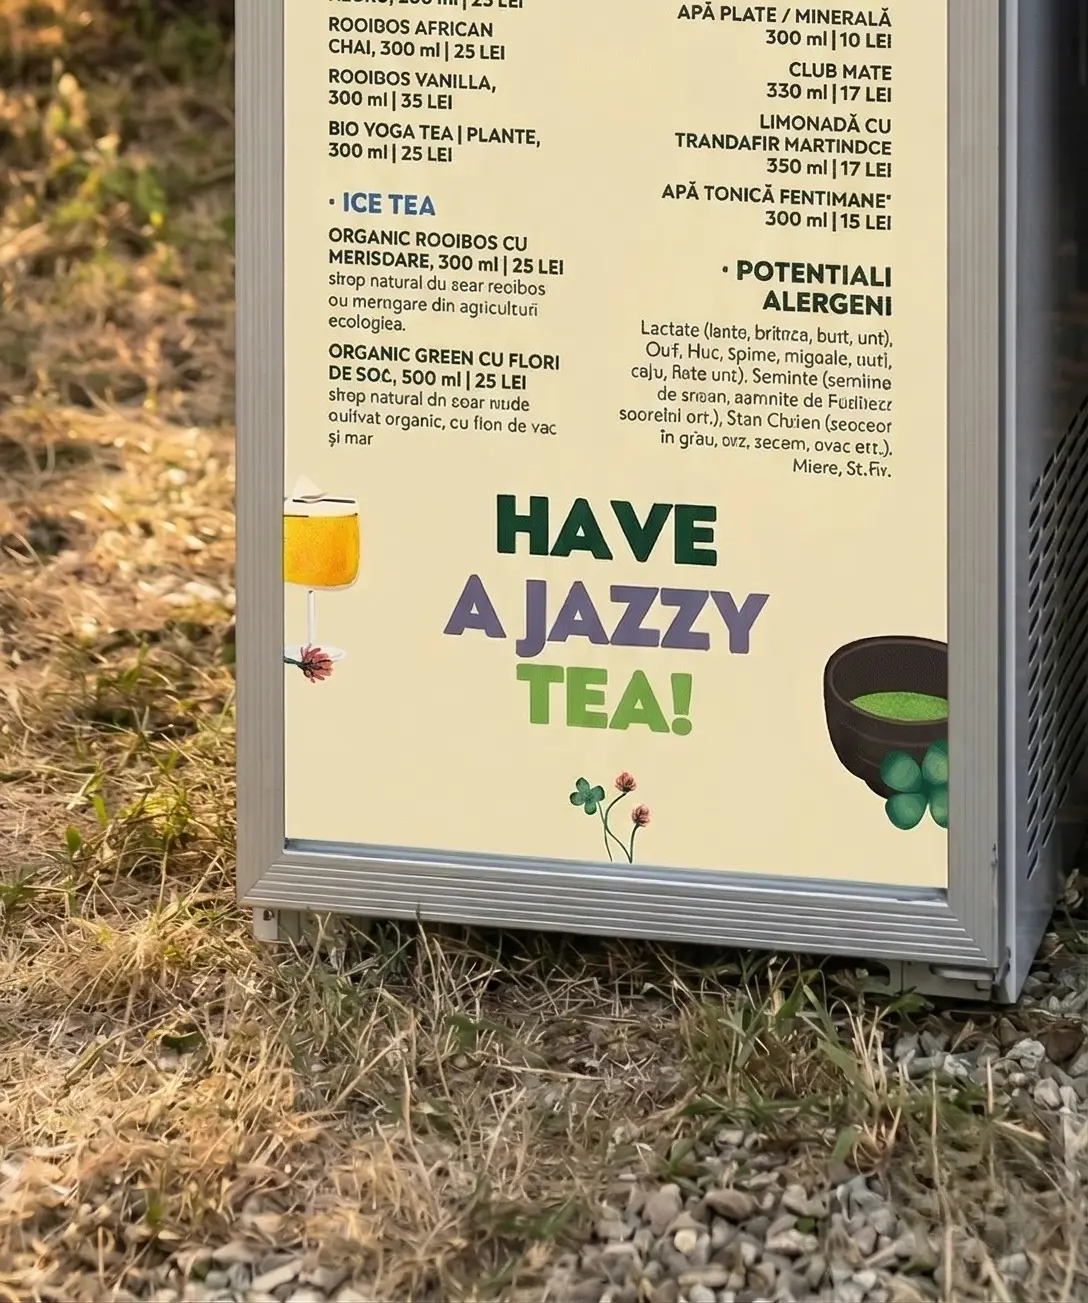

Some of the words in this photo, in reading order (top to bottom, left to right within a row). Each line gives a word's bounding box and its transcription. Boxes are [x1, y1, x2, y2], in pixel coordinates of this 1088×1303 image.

[328, 16, 411, 35] ROOIBOS
[414, 19, 494, 38] AFRICAN
[765, 28, 802, 46] 300
[806, 30, 828, 47] ml
[839, 31, 861, 49] 10
[865, 32, 892, 49] LEI
[328, 68, 411, 87] ROOIBOS
[414, 71, 497, 94] VANILLA,
[788, 61, 838, 79] CLUB
[842, 63, 893, 81] MATE
[328, 120, 360, 137] BIO
[363, 121, 416, 140] YOGA
[418, 124, 455, 142] TEA
[466, 126, 541, 149] PLANTE,
[759, 112, 861, 134] LIMONADĂ
[864, 117, 892, 135] CU
[343, 191, 383, 214] ICE
[387, 193, 436, 217] TEA
[328, 227, 411, 247] ORGANIC
[415, 231, 499, 251] ROOIBOS
[502, 235, 528, 252] CU
[736, 259, 892, 288] POTENTIALI
[761, 289, 893, 317] ALERGENI
[640, 319, 700, 338] Lactate
[328, 342, 411, 363] ORGANIC
[414, 347, 474, 366] GREEN
[478, 350, 504, 368] CU
[508, 352, 560, 371] FLORI
[792, 457, 843, 478] Miere,
[496, 494, 718, 567] HAVE
[443, 574, 507, 640] A
[516, 580, 770, 658] JAZZY
[515, 663, 694, 737] TEA!
